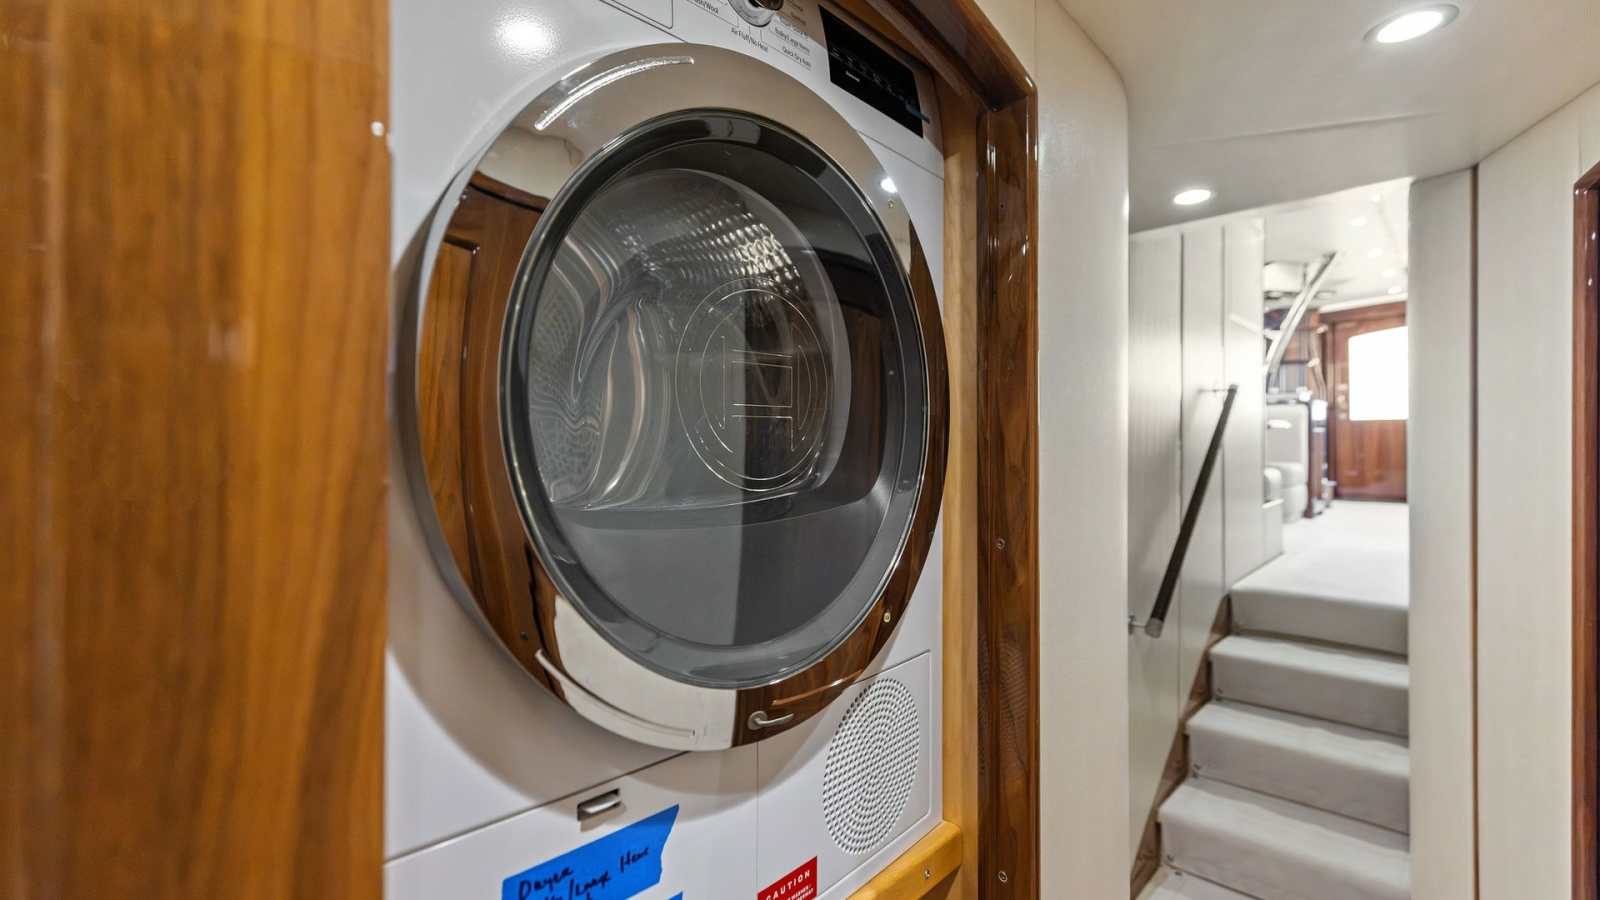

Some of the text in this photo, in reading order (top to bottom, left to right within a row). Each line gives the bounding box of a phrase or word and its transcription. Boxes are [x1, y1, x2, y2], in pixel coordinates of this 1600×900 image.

[738, 30, 758, 47] Fluff/No
[758, 43, 769, 53] Heat
[775, 27, 799, 47] Bulky/Large
[782, 46, 794, 57] Quick
[802, 58, 812, 68] Auto
[766, 869, 810, 900] CAUTION
